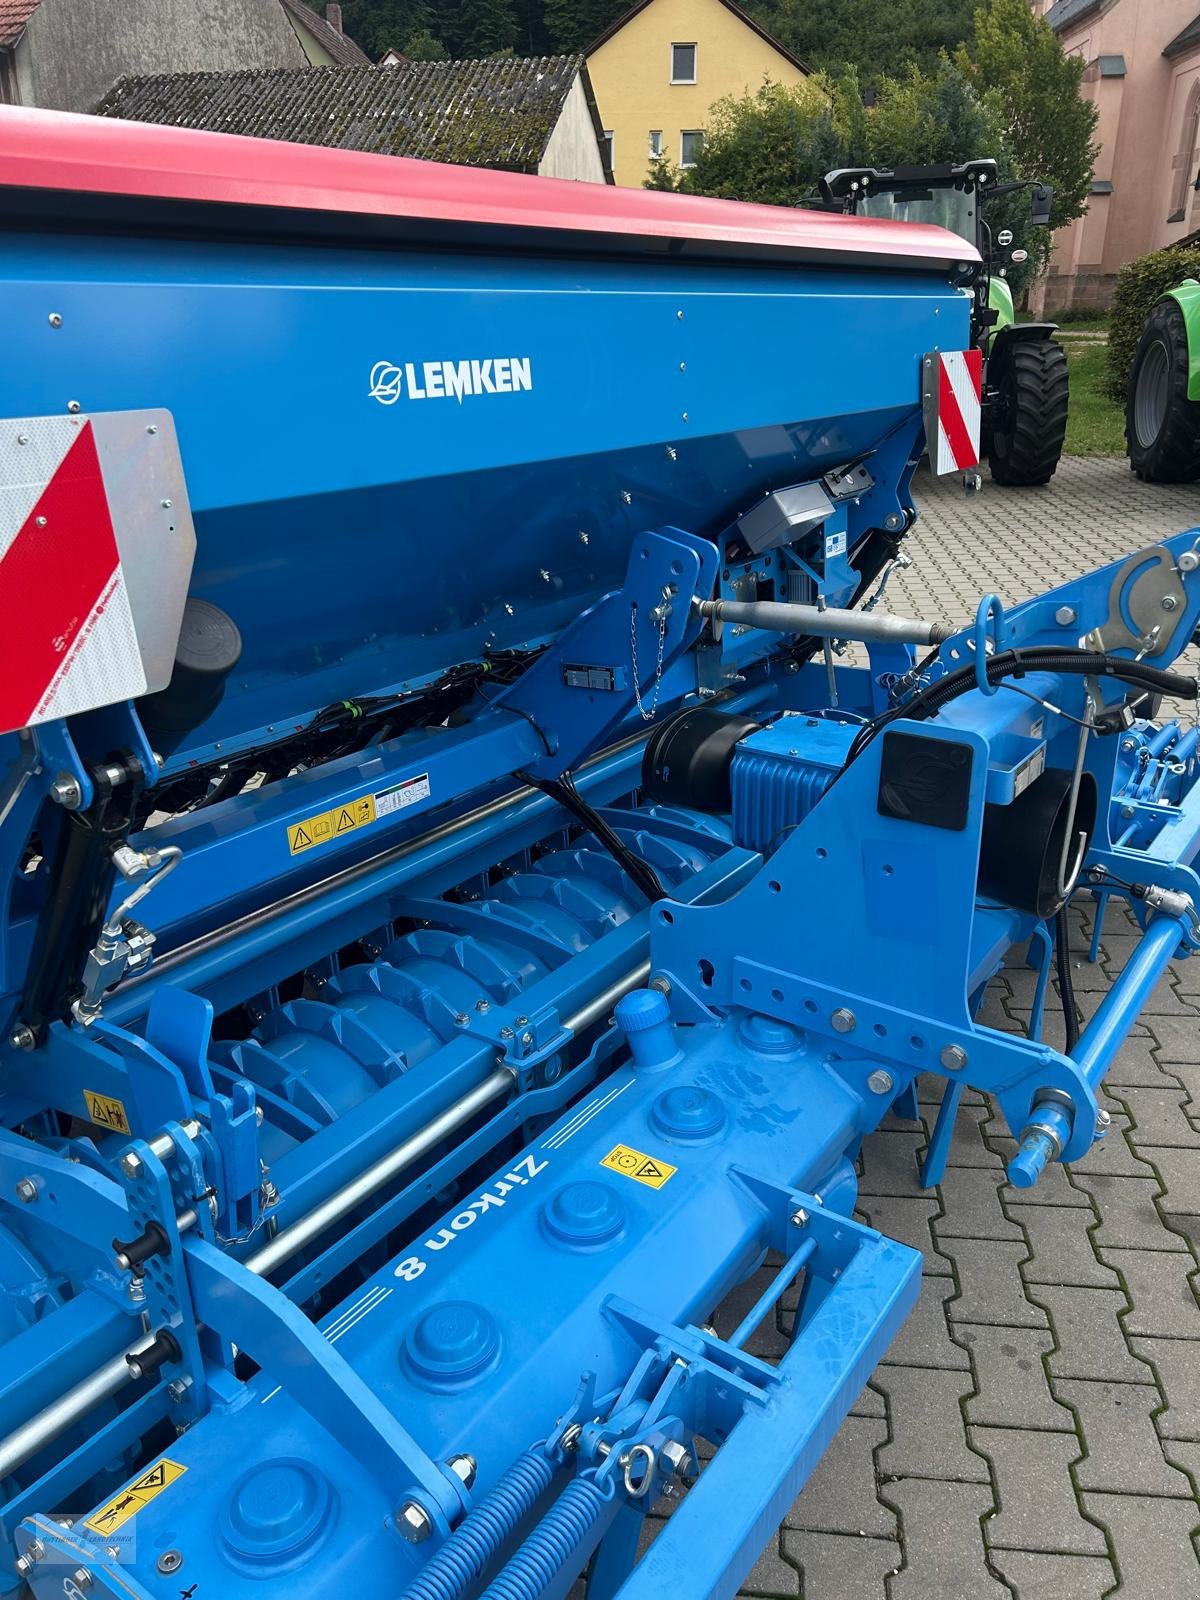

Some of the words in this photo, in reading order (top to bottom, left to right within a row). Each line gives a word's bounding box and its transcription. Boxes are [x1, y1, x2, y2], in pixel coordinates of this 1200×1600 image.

[405, 357, 533, 405] LEMKEN
[424, 1154, 550, 1250] Zirkon
[394, 1256, 427, 1282] 8
